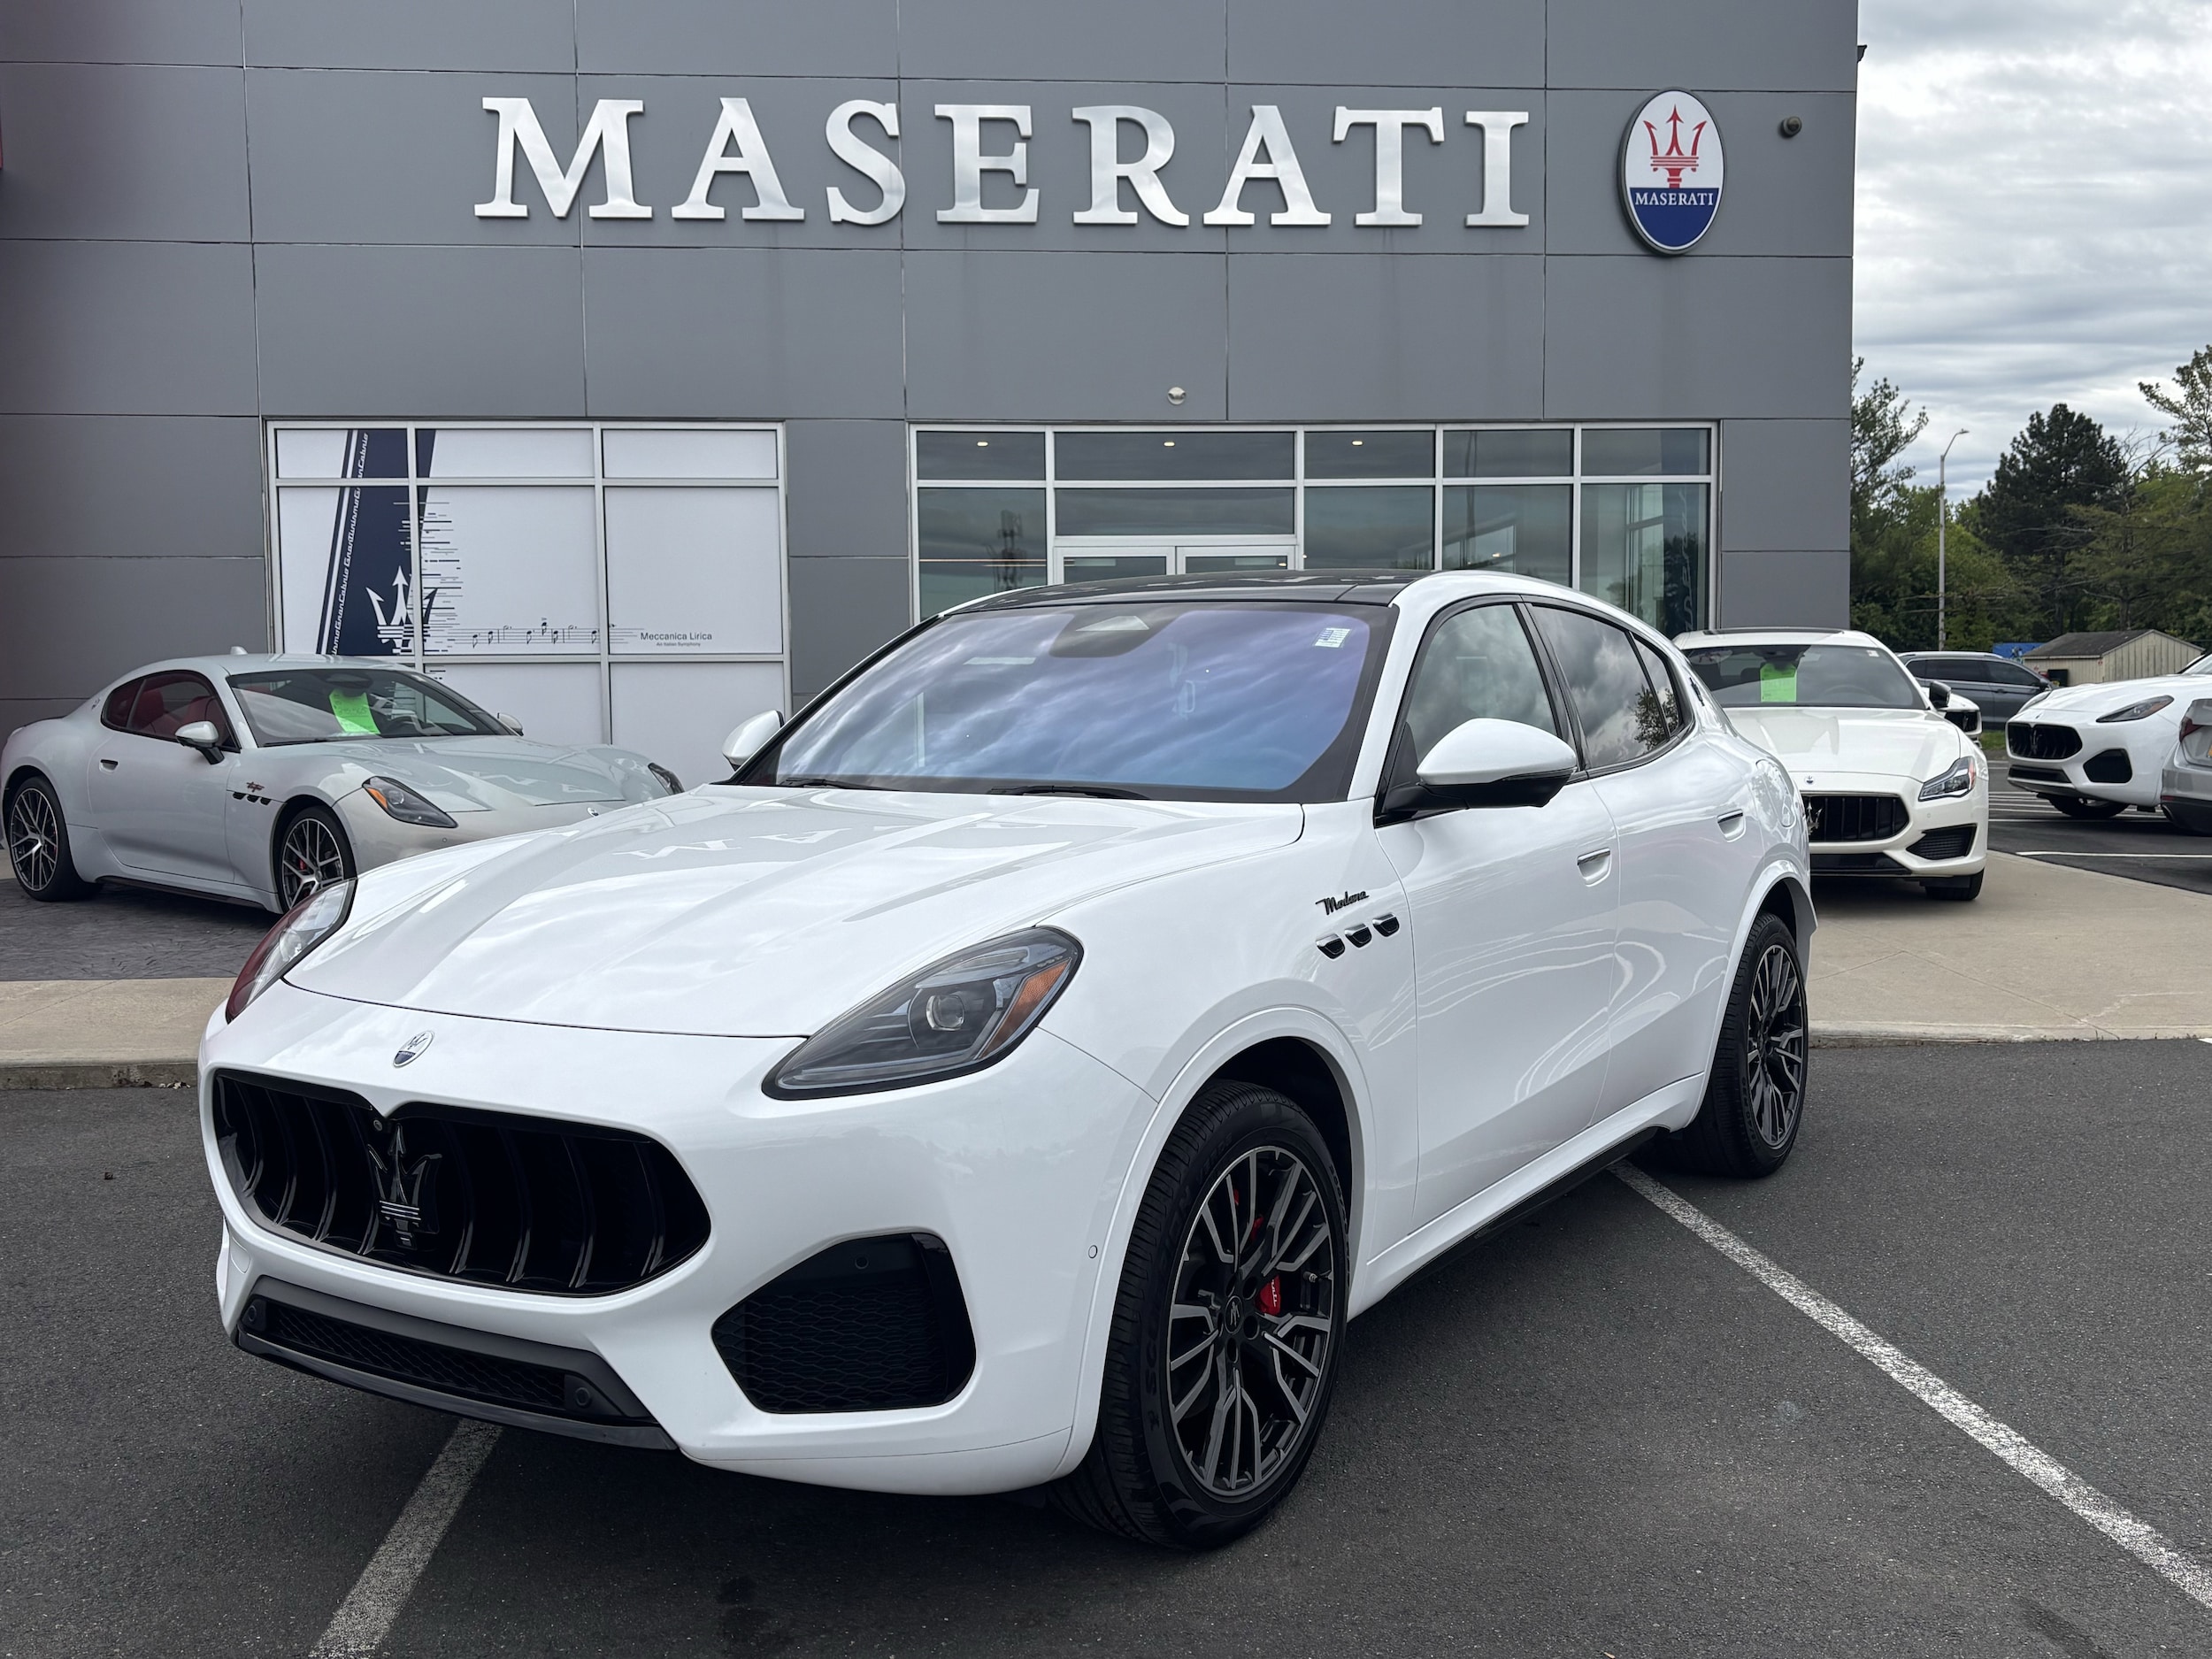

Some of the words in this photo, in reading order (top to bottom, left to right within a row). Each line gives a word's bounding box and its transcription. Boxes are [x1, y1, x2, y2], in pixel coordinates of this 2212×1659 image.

[474, 96, 1531, 227] MASERATI
[1634, 192, 1714, 206] MASERATI
[640, 632, 687, 641] Meccanica
[689, 632, 712, 641] Lirica
[1315, 890, 1370, 916] Modena
